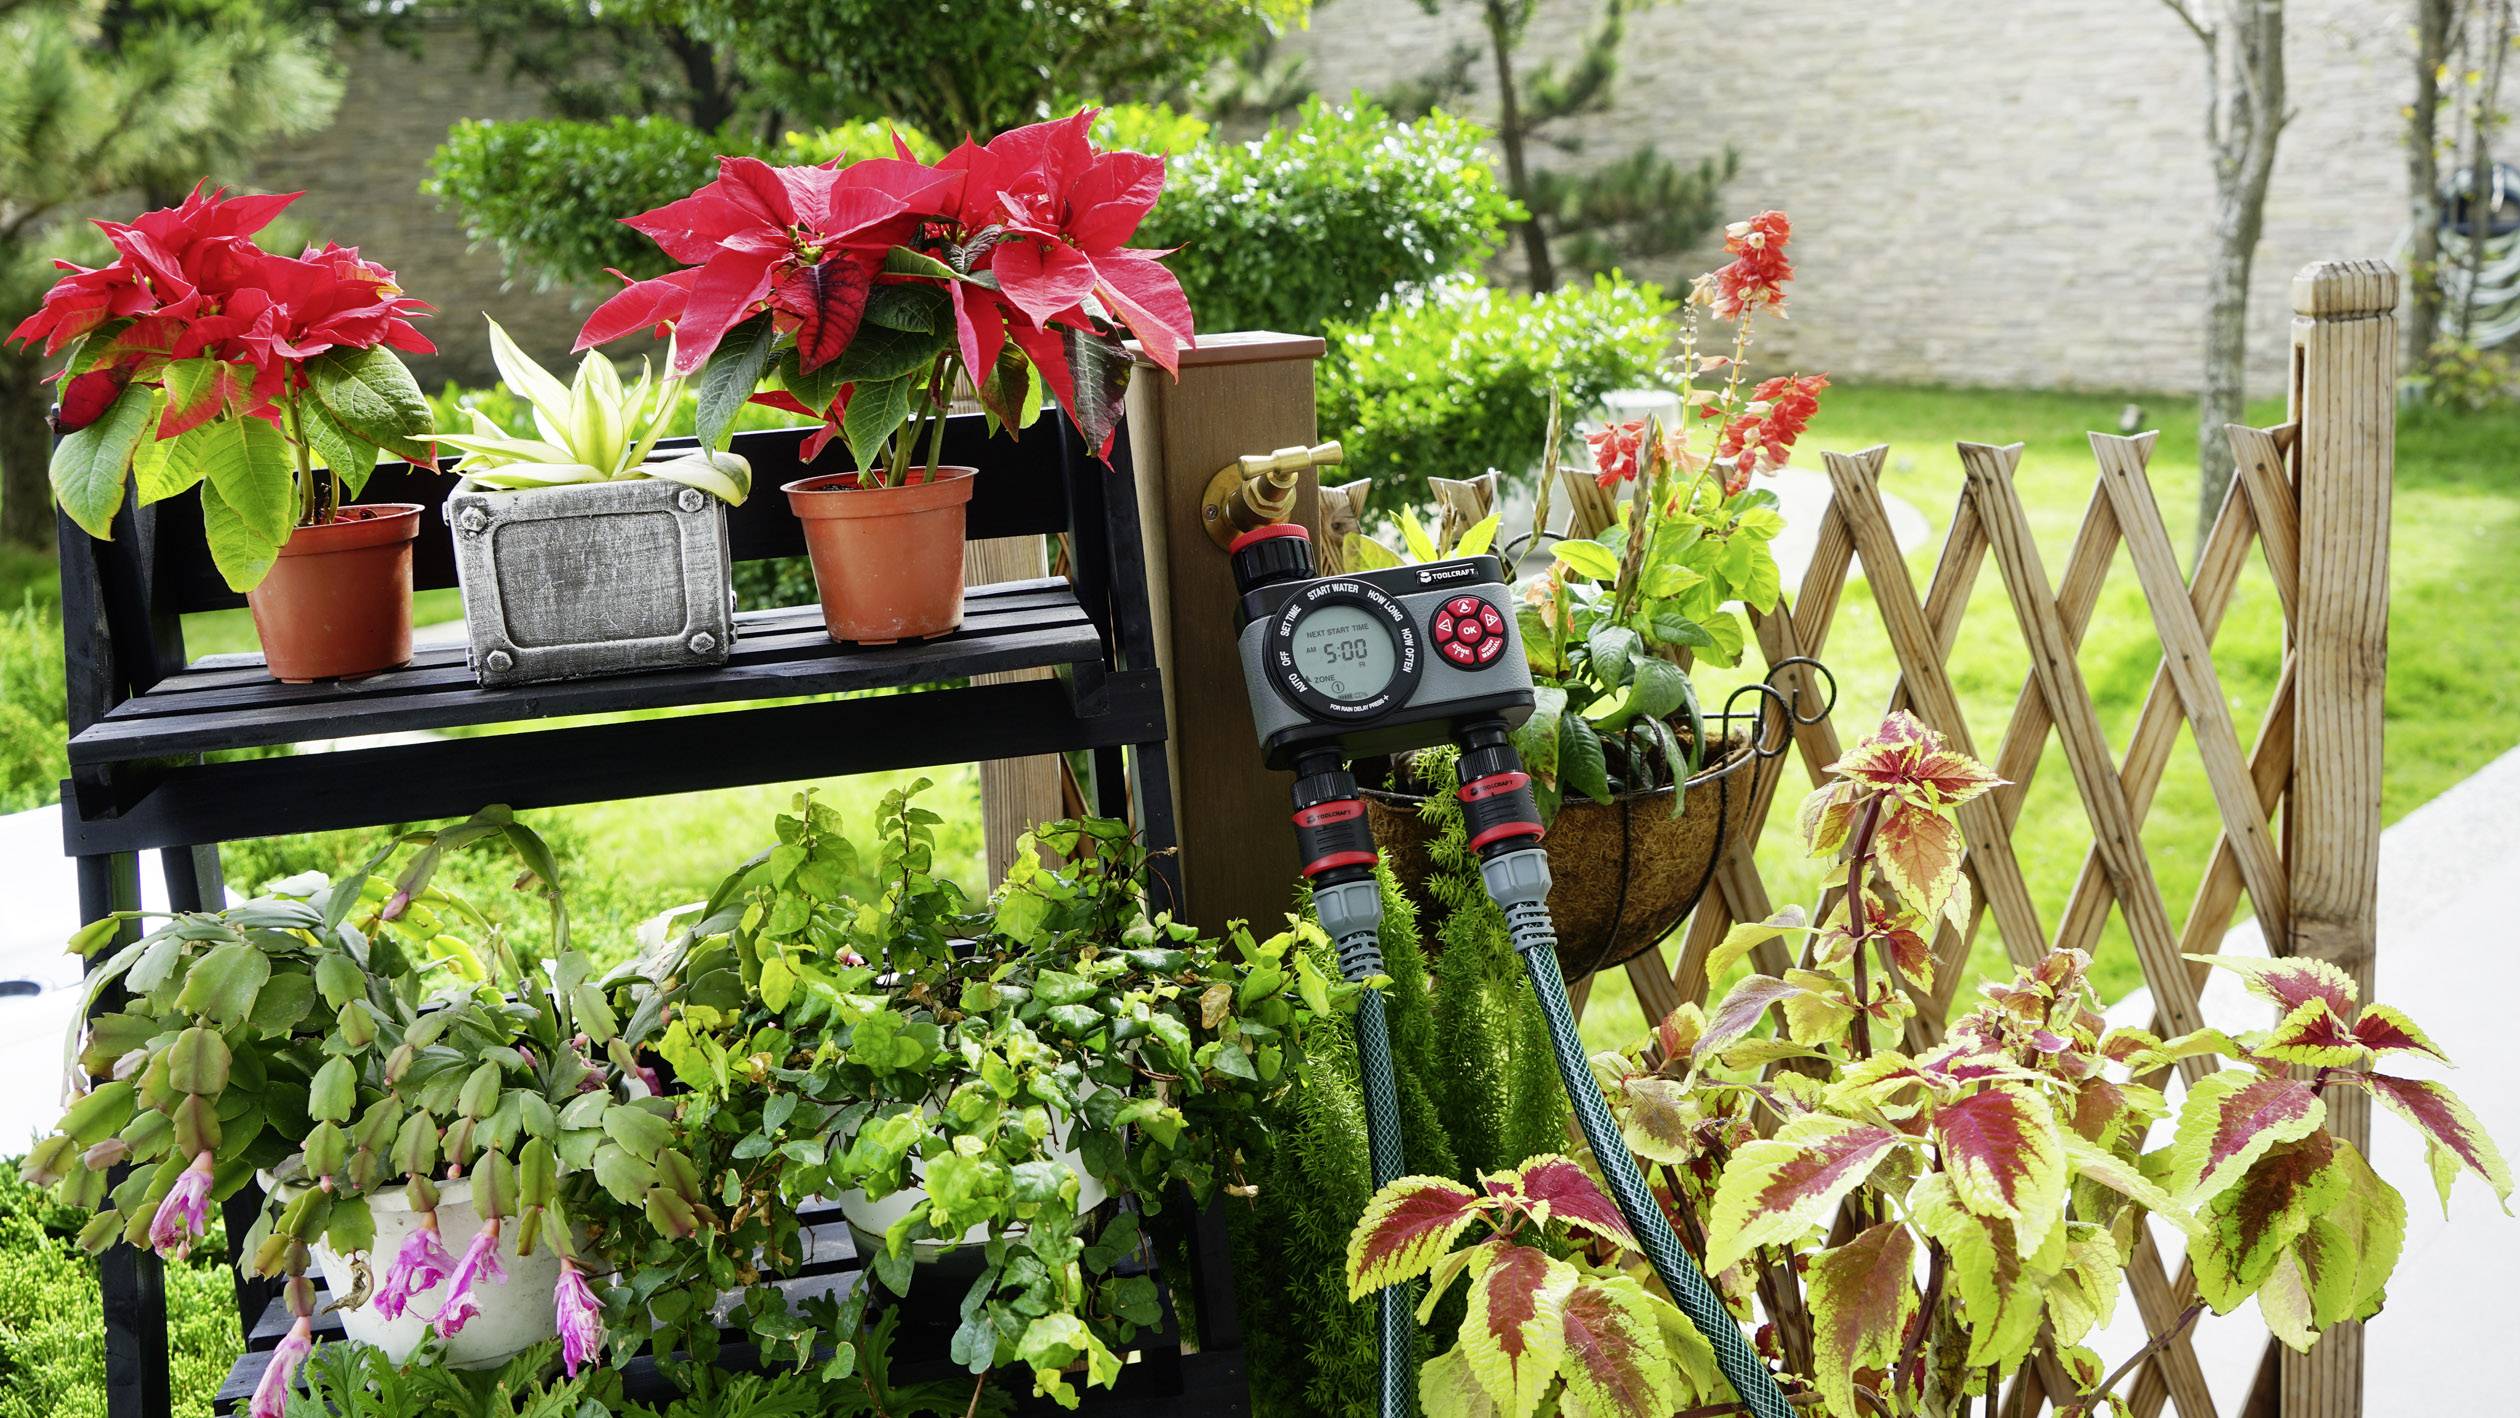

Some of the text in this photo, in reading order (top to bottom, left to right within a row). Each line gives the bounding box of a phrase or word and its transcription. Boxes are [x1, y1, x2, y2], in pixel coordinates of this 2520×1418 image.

[1432, 568, 1475, 580] TOOLCRAFT
[1307, 583, 1359, 601] START WATER
[1367, 589, 1404, 622] HOW LONG
[1280, 604, 1302, 637] SET TIME
[1307, 623, 1369, 638] NEXT START TIME
[1463, 626, 1477, 635] OK
[1306, 638, 1368, 664] AM 5:00
[1401, 628, 1414, 673] HOW OFTEN
[1453, 643, 1470, 655] ZONE
[1482, 640, 1500, 659] MANUAL
[1280, 651, 1292, 667] OFF
[1288, 673, 1308, 693] AUTO
[1314, 674, 1335, 684] ZONE
[1330, 703, 1341, 711] FOR
[1353, 704, 1369, 712] DELAY
[1368, 698, 1385, 709] PRESS
[1316, 809, 1352, 820] TOOLCRAFT
